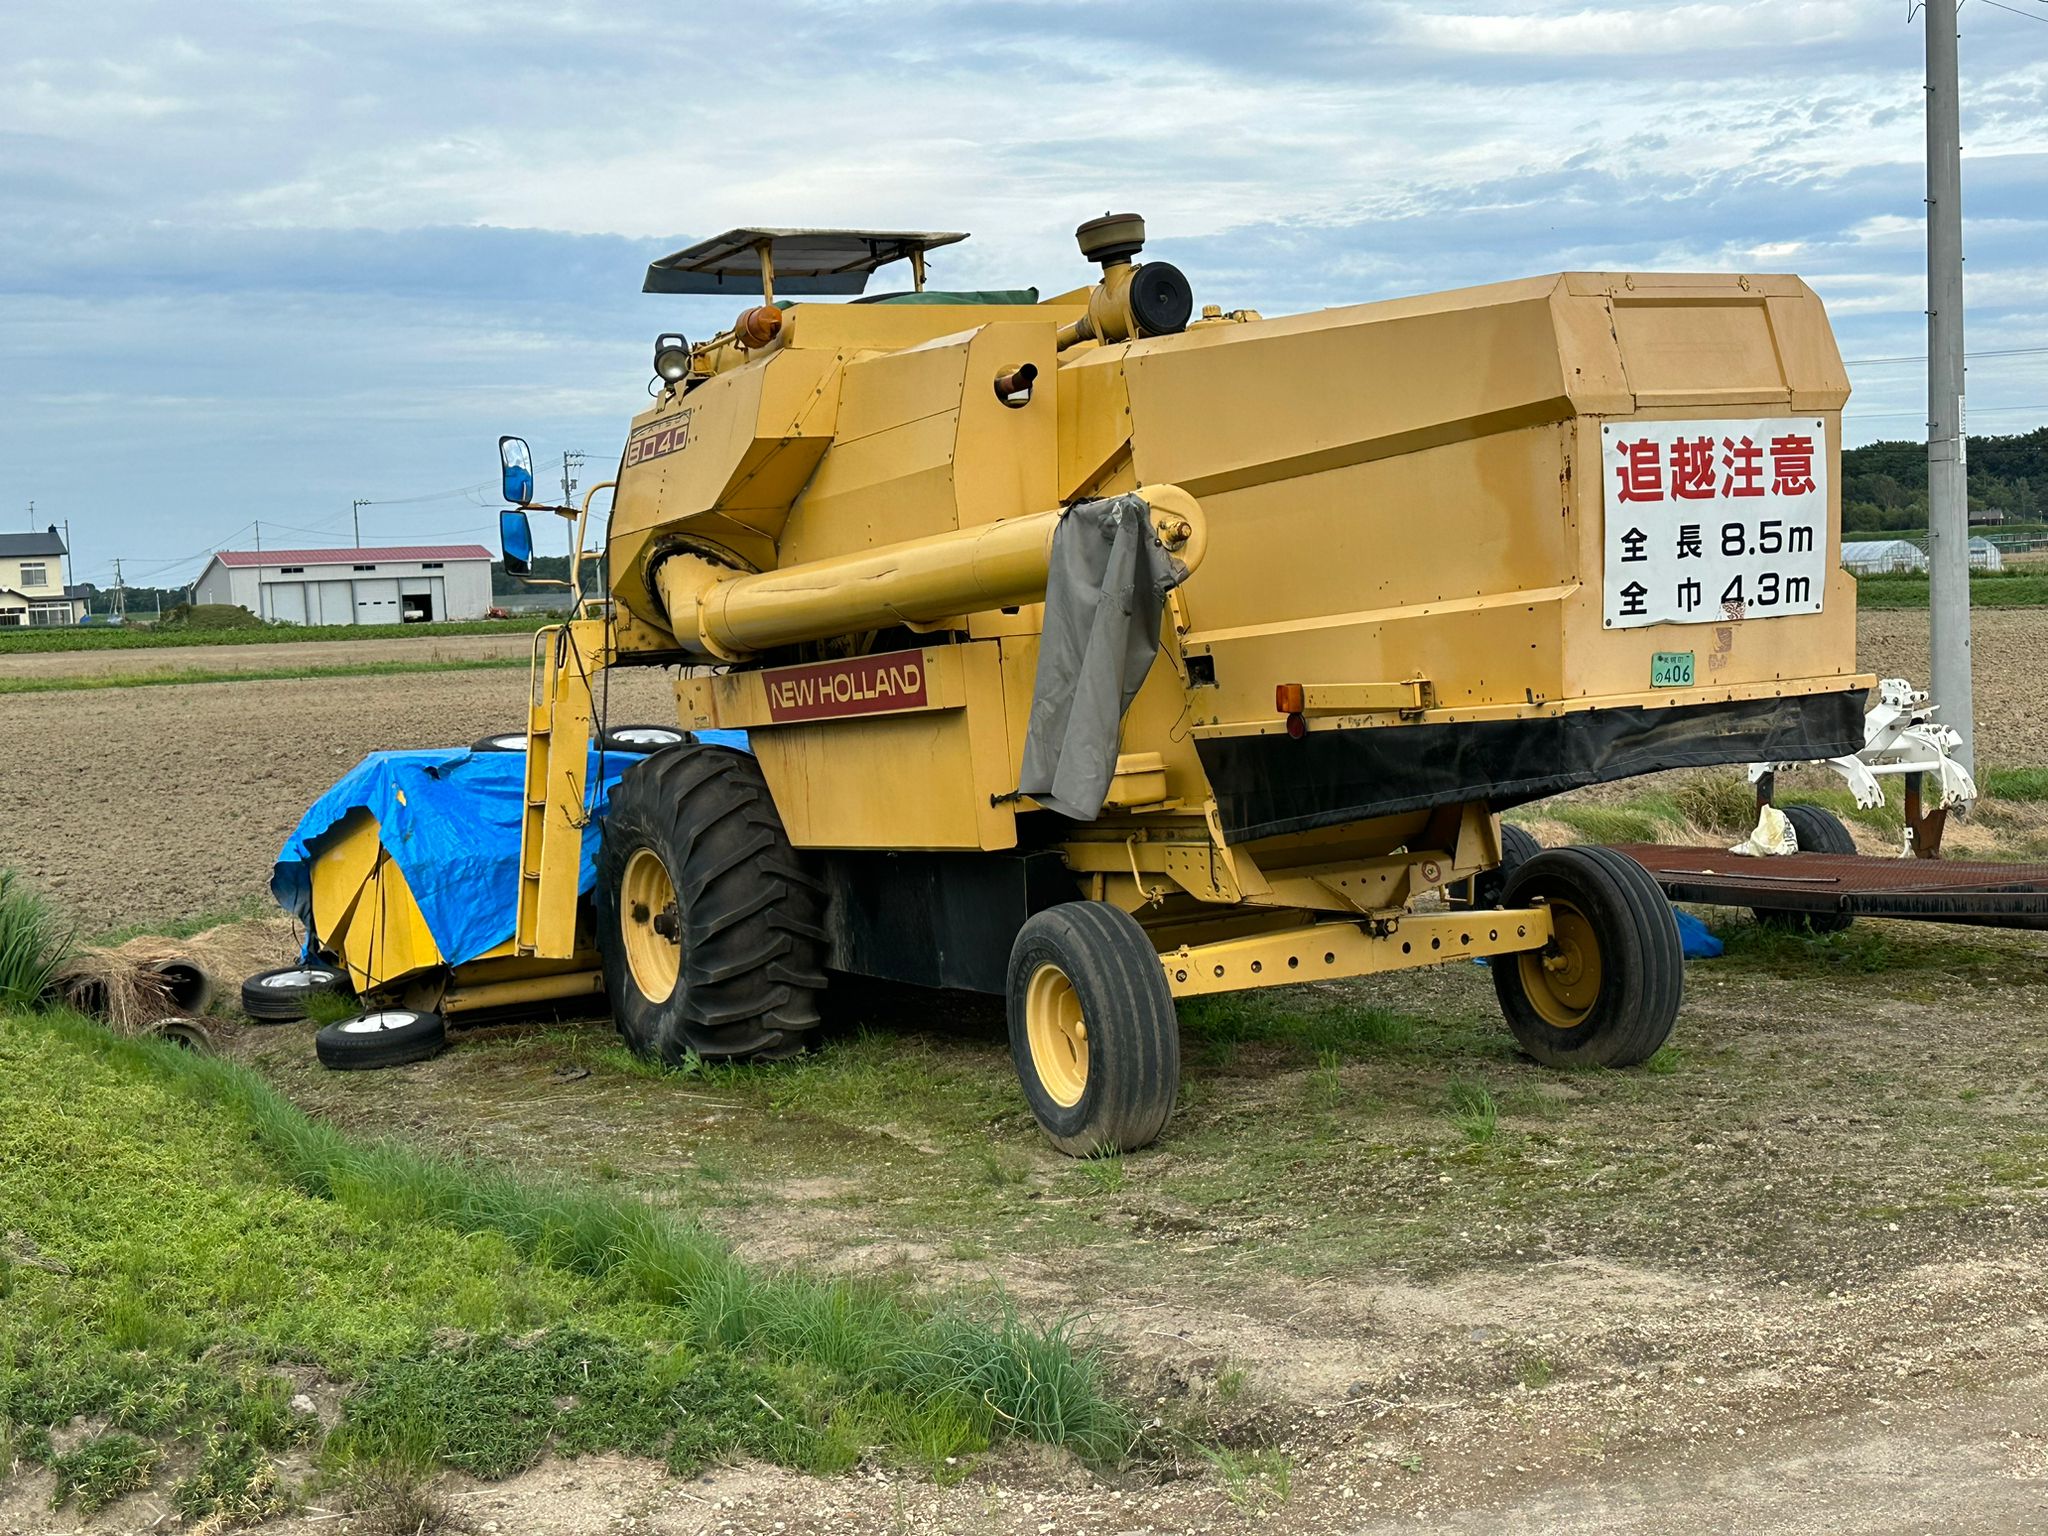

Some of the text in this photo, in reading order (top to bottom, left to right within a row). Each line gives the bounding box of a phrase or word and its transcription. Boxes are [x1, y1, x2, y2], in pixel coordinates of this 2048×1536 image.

[627, 429, 686, 466] 8040
[1616, 434, 1816, 503] 追越注意
[1621, 520, 1813, 562] 全 長 8.5m
[1619, 572, 1810, 615] 全 巾 4.3m
[770, 664, 921, 709] NEW HOLLAND
